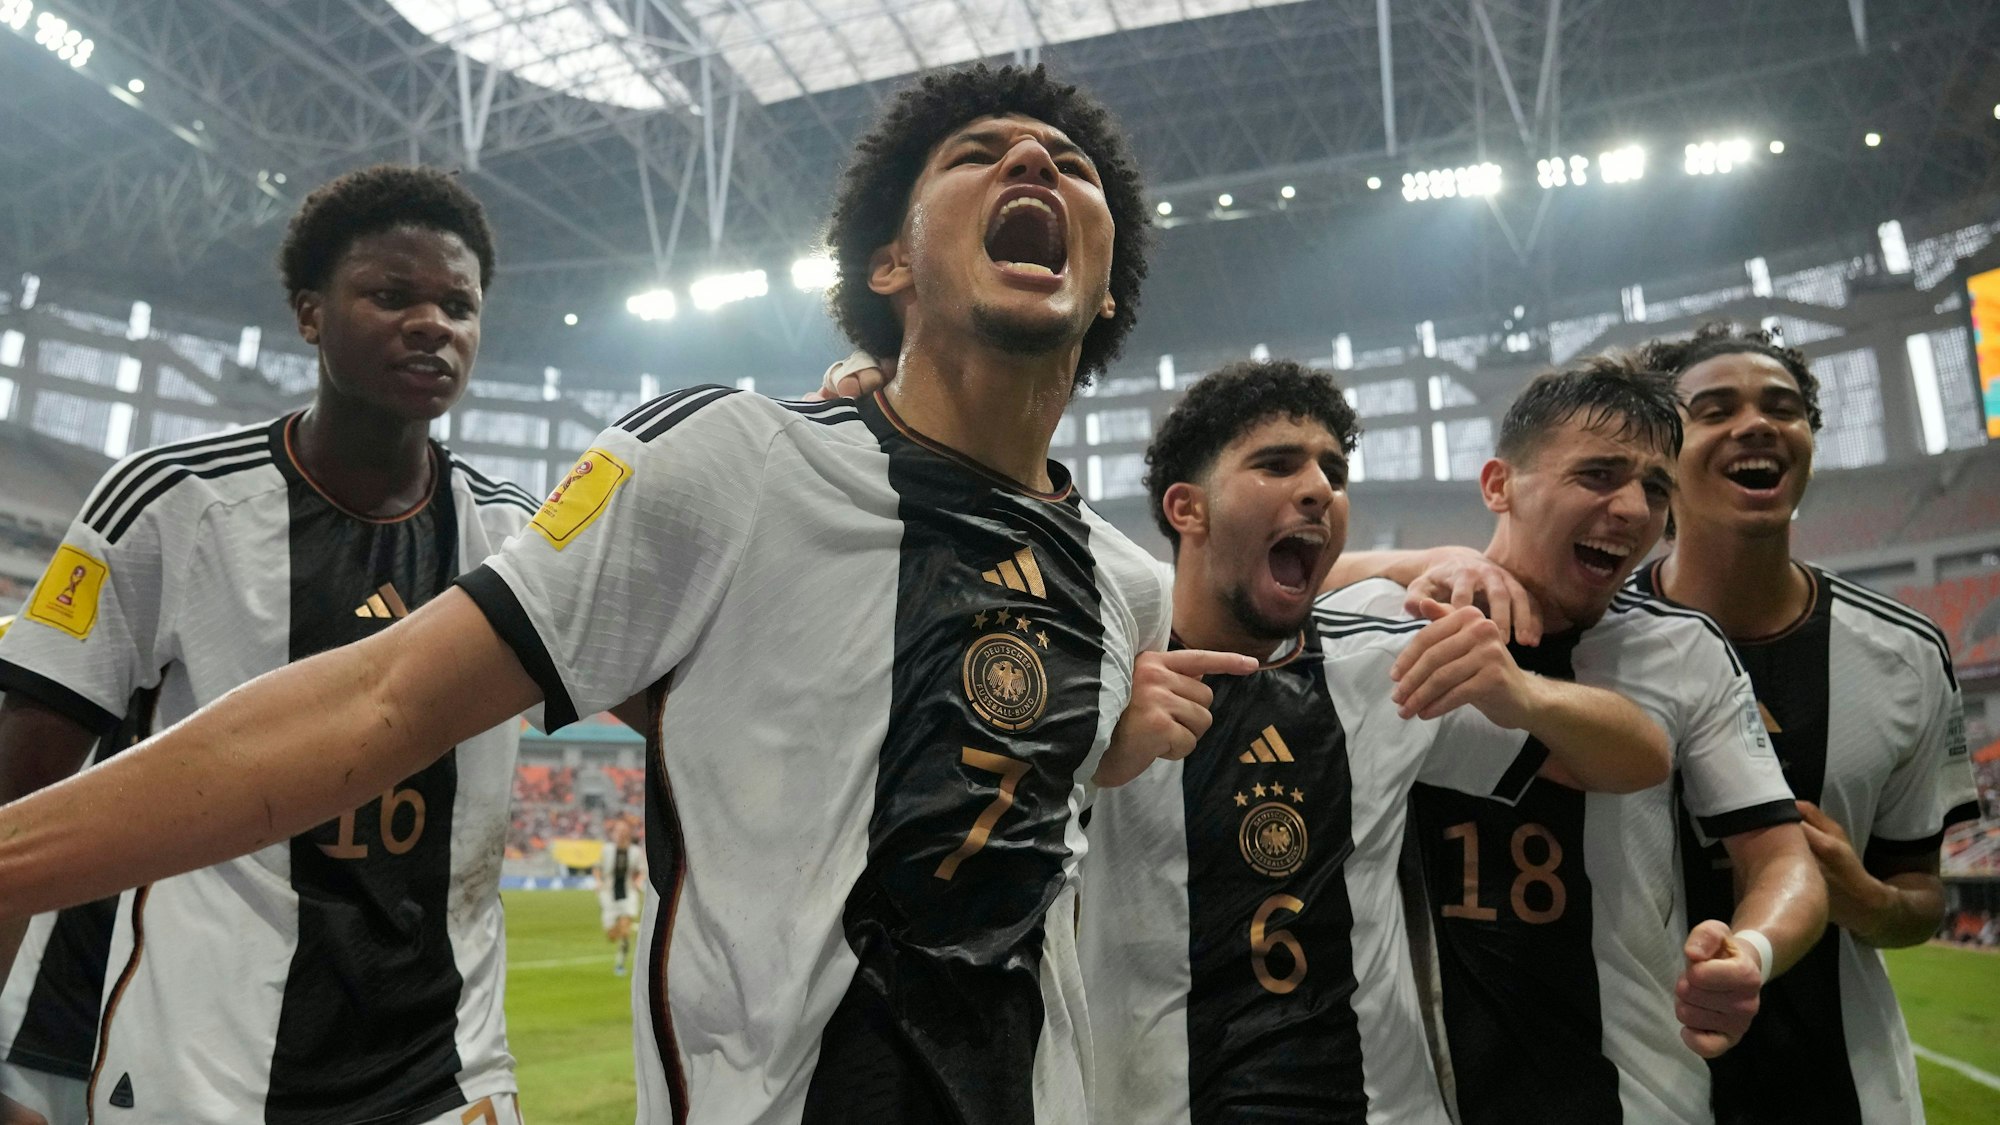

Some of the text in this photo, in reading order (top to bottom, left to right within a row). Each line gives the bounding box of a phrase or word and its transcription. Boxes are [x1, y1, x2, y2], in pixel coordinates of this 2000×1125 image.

[976, 683, 1035, 717] FUSSBALL-BUND
[983, 645, 1032, 670] DEUTSCHER
[315, 784, 426, 859] 16
[933, 746, 1032, 881] 7
[1441, 820, 1567, 925] 18
[1250, 893, 1308, 994] 6
